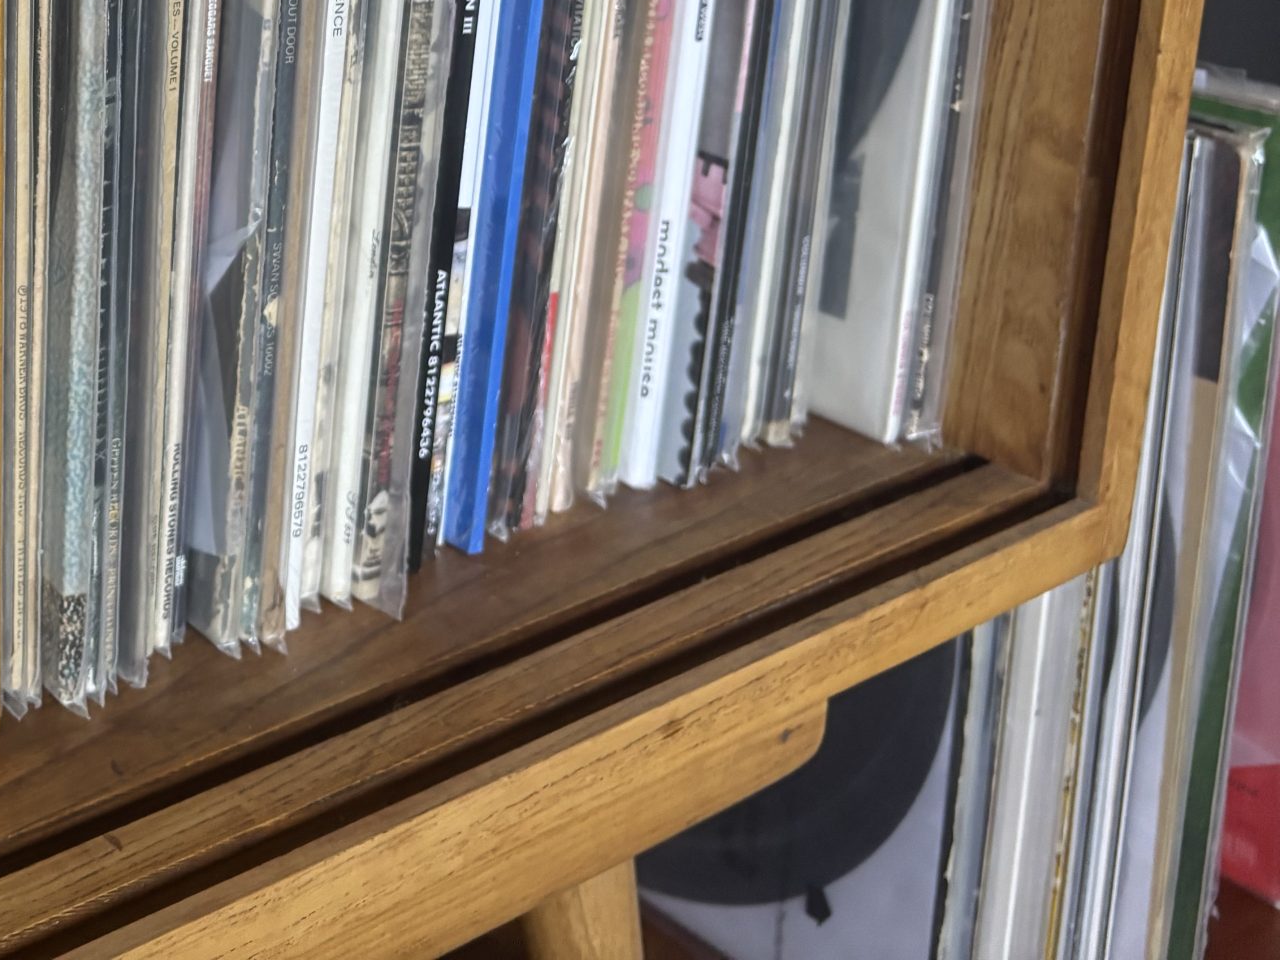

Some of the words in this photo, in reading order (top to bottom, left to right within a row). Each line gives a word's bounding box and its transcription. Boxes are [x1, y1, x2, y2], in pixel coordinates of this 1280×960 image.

[285, 26, 297, 64] DOOR
[461, 15, 475, 35] III
[269, 242, 282, 282] SWAN
[429, 269, 447, 351] ATLANTIC
[418, 355, 440, 458] 8122796436
[291, 444, 308, 538] 8122796579
[162, 557, 175, 620] RECORDS
